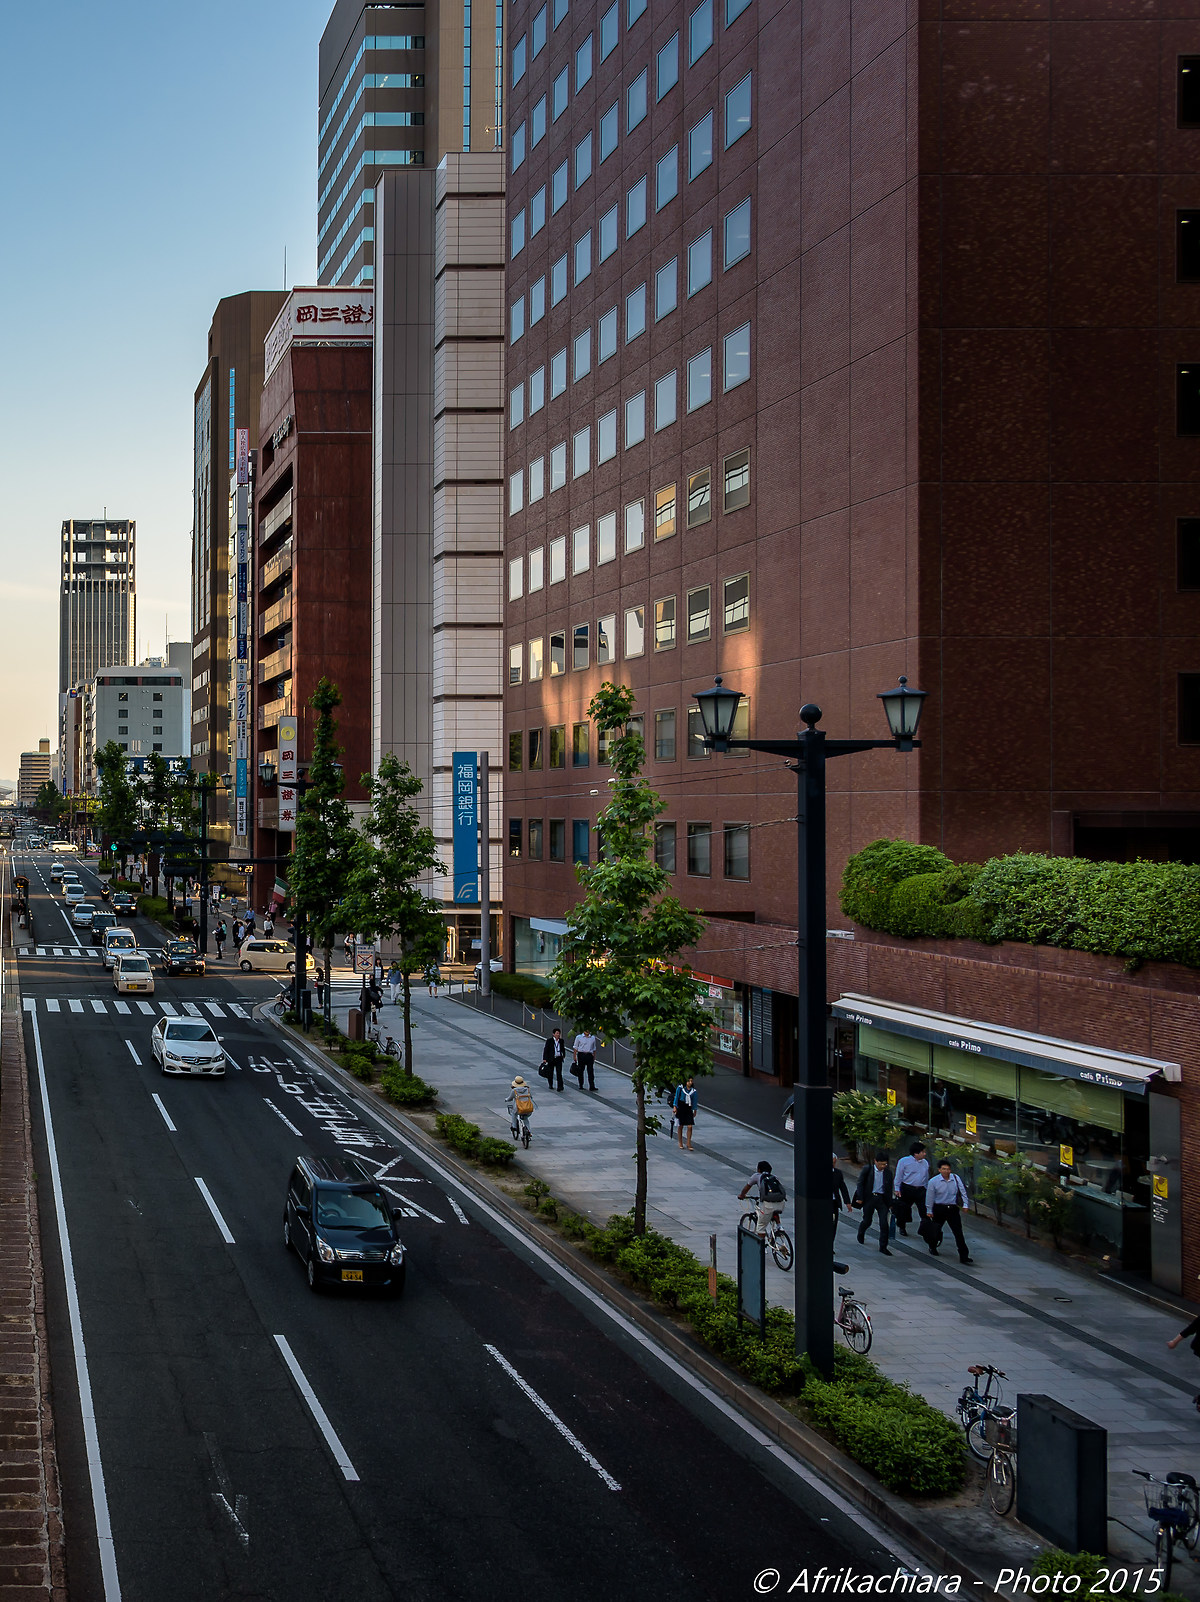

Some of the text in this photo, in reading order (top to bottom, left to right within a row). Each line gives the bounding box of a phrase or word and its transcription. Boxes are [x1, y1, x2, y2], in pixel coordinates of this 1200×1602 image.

[280, 750, 295, 821] 岡三證券
[457, 764, 474, 826] 福岡銀行
[855, 1014, 873, 1025] Primo
[960, 1040, 982, 1053] Primo
[1095, 1073, 1123, 1087] Primo
